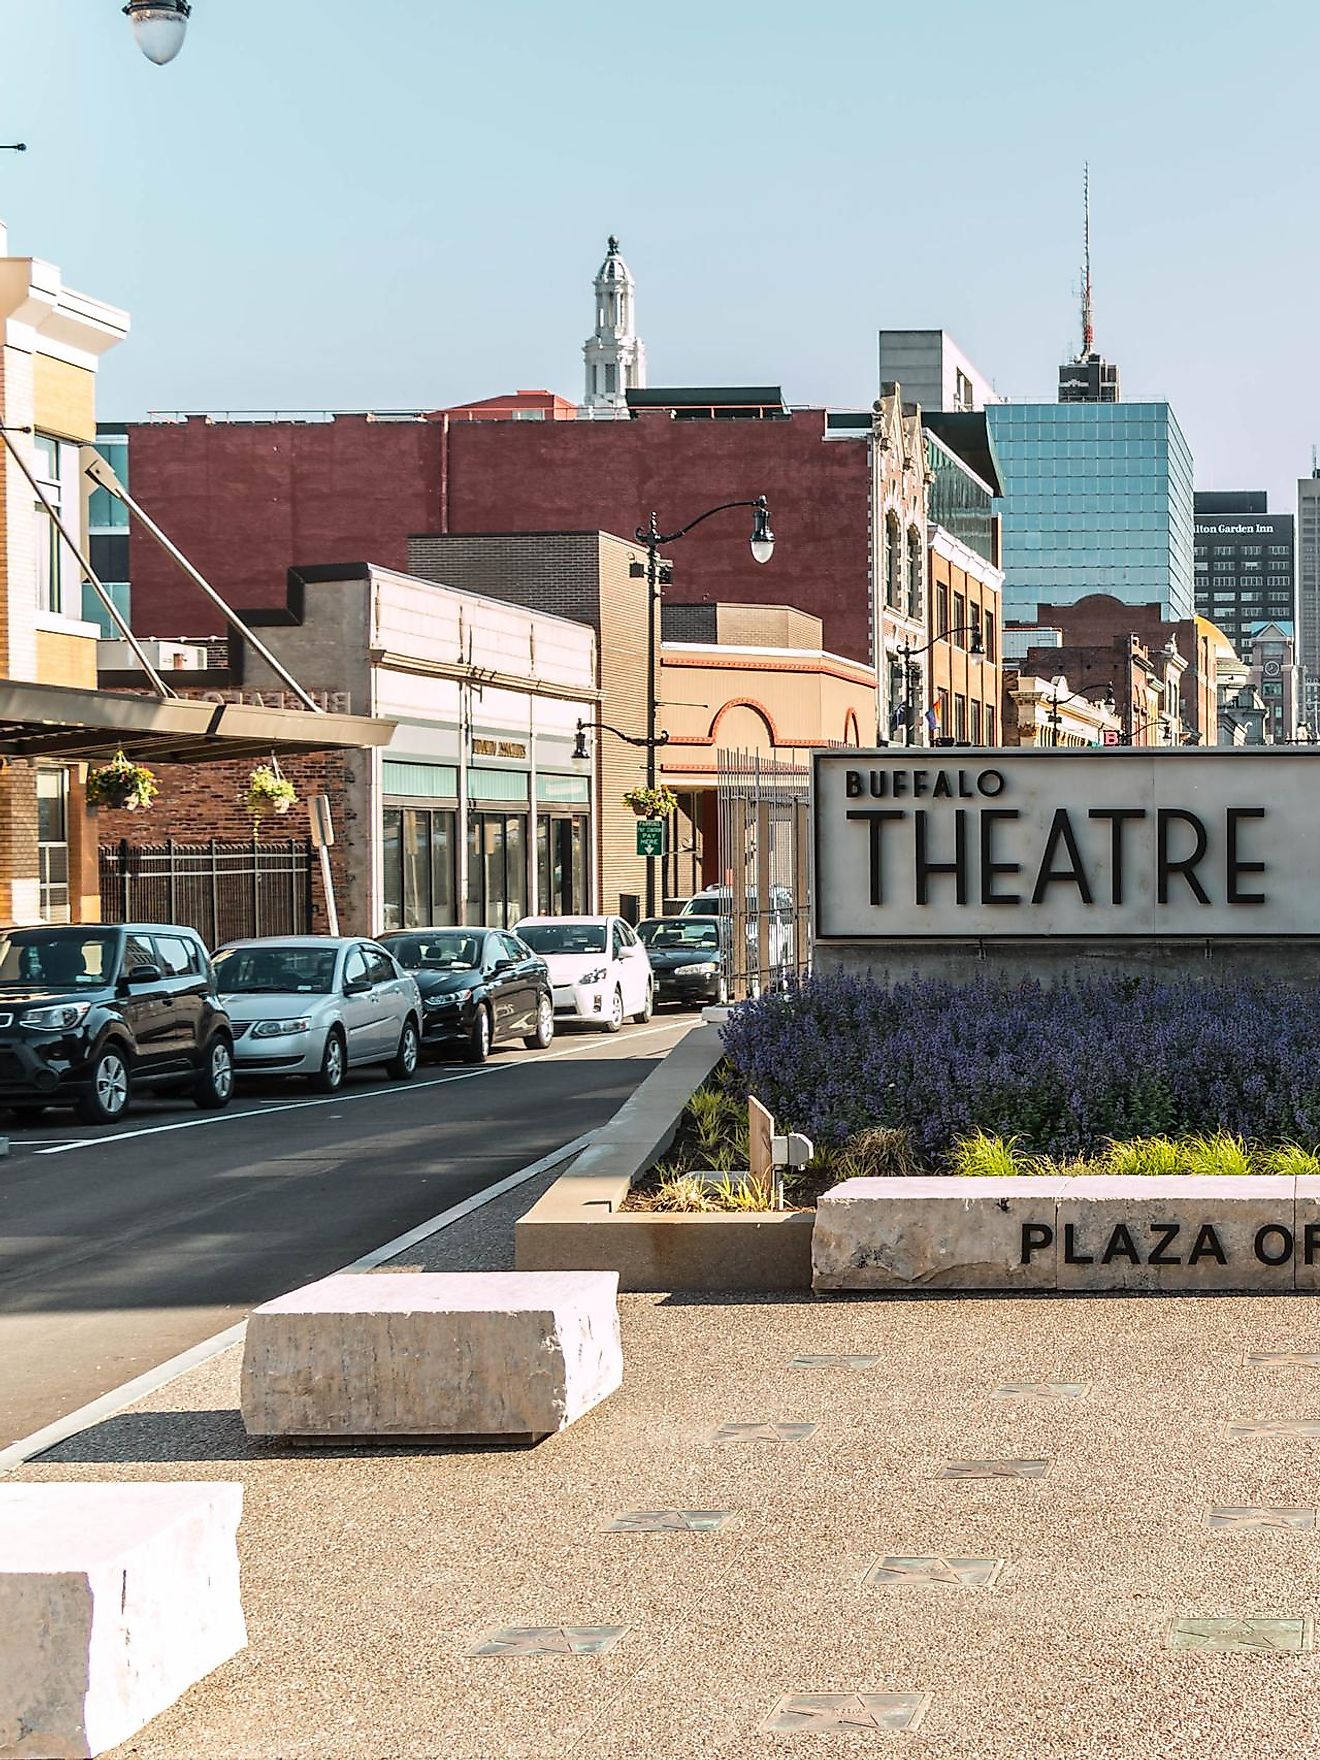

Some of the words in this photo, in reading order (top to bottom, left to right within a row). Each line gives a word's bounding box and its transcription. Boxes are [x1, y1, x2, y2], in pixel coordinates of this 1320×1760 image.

[1218, 523, 1254, 534] Garden
[1255, 523, 1274, 534] Inn
[846, 769, 1005, 798] BUFFALO
[846, 808, 1265, 906] THEATRE
[1020, 1223, 1228, 1265] PLAZA
